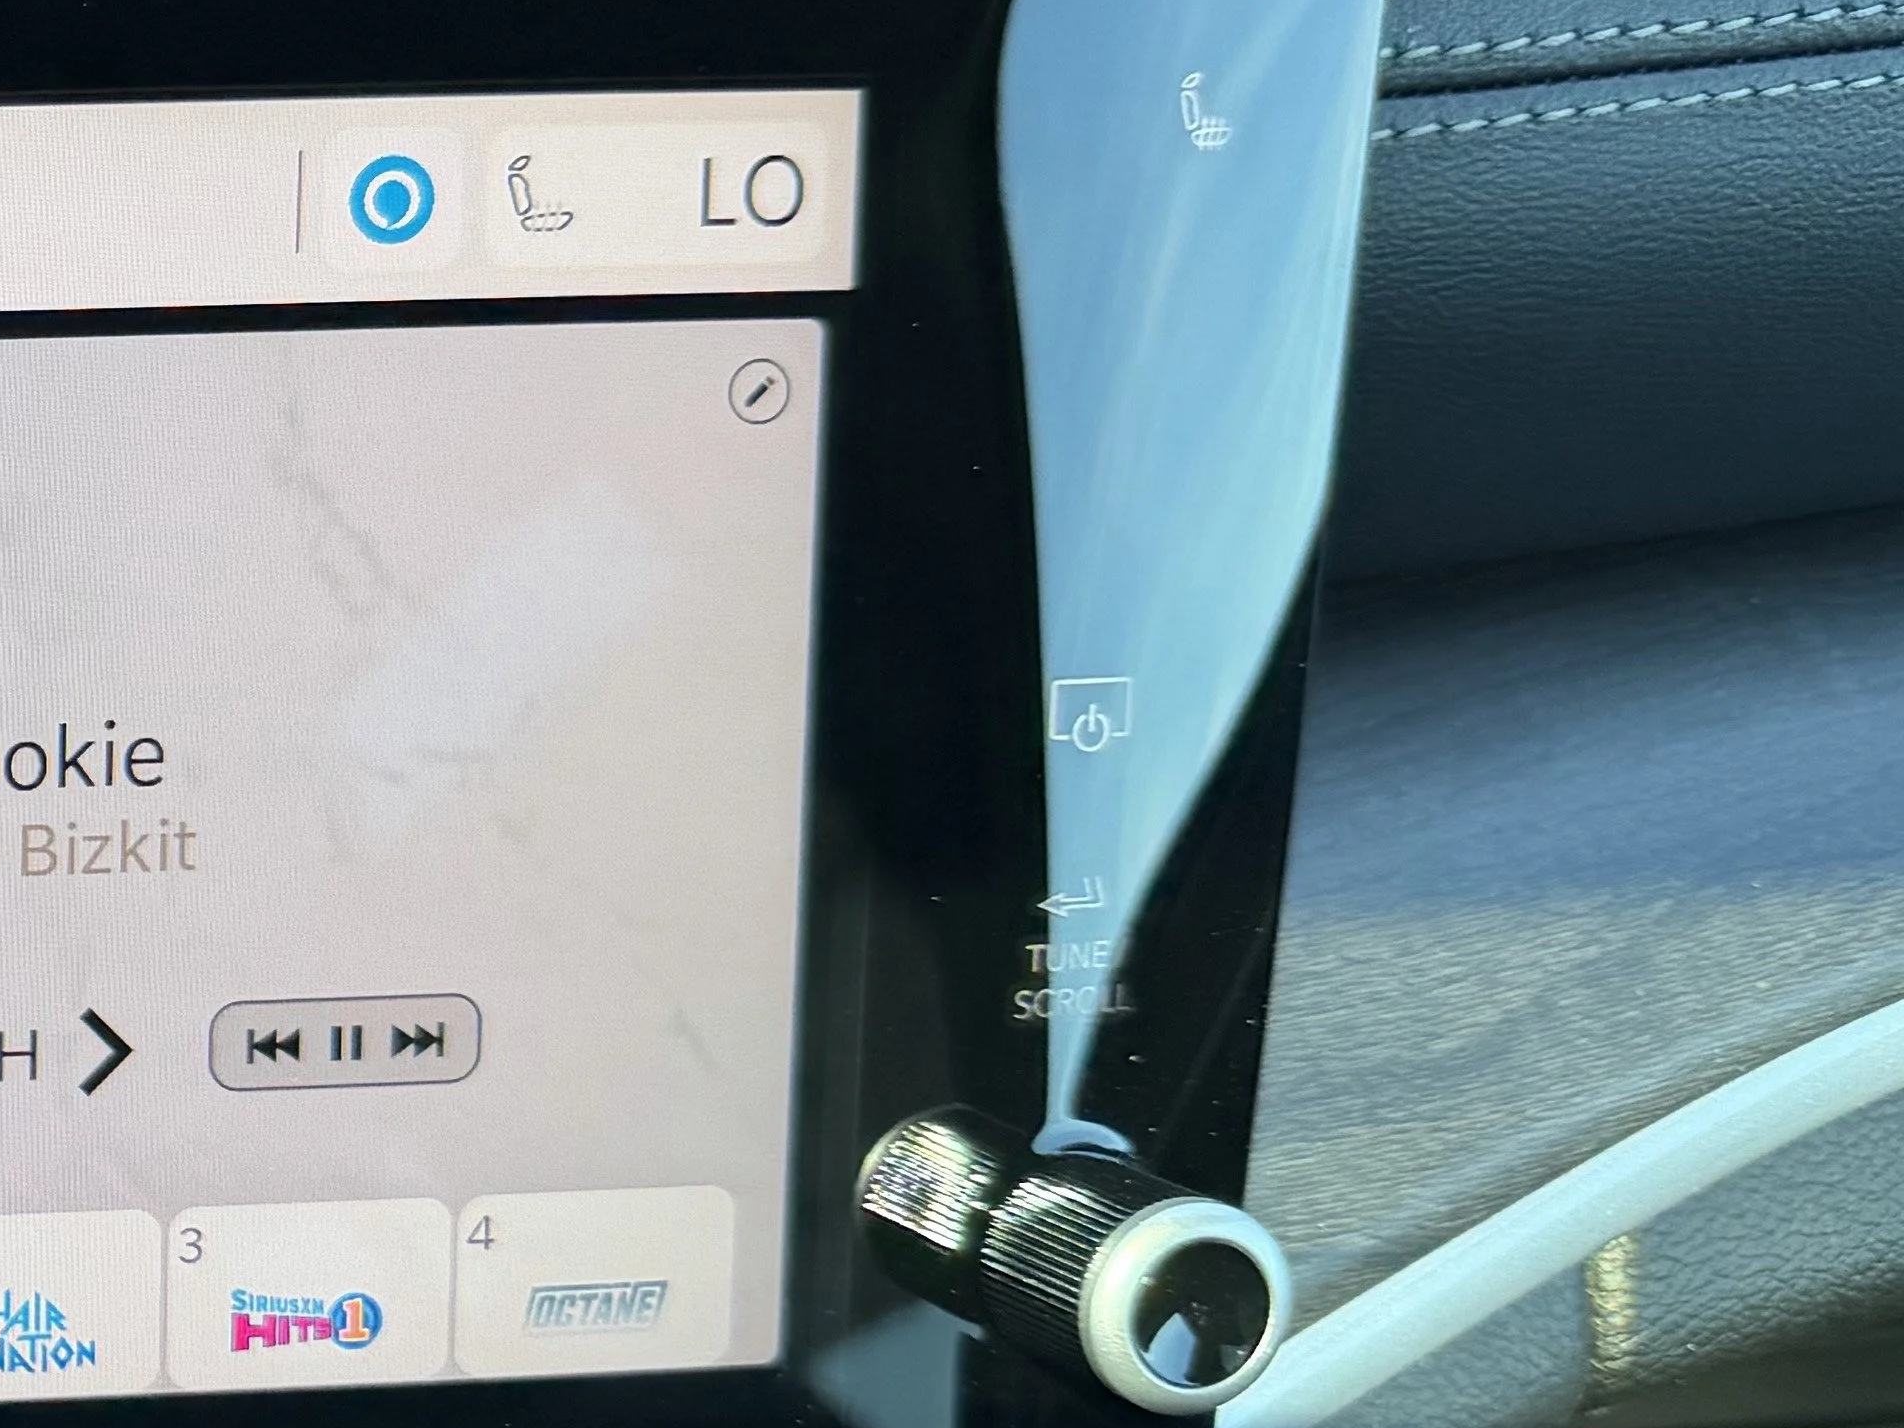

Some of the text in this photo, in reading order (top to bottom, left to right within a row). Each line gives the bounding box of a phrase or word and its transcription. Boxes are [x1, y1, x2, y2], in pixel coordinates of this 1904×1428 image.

[700, 152, 805, 227] LO
[19, 818, 197, 878] Bizkit
[1023, 939, 1113, 974] TUNE
[1011, 982, 1138, 1021] SCROLL
[178, 1227, 204, 1264] 3
[466, 1214, 496, 1251] 4
[531, 1288, 659, 1329] OCTANE
[230, 1311, 333, 1353] HITS
